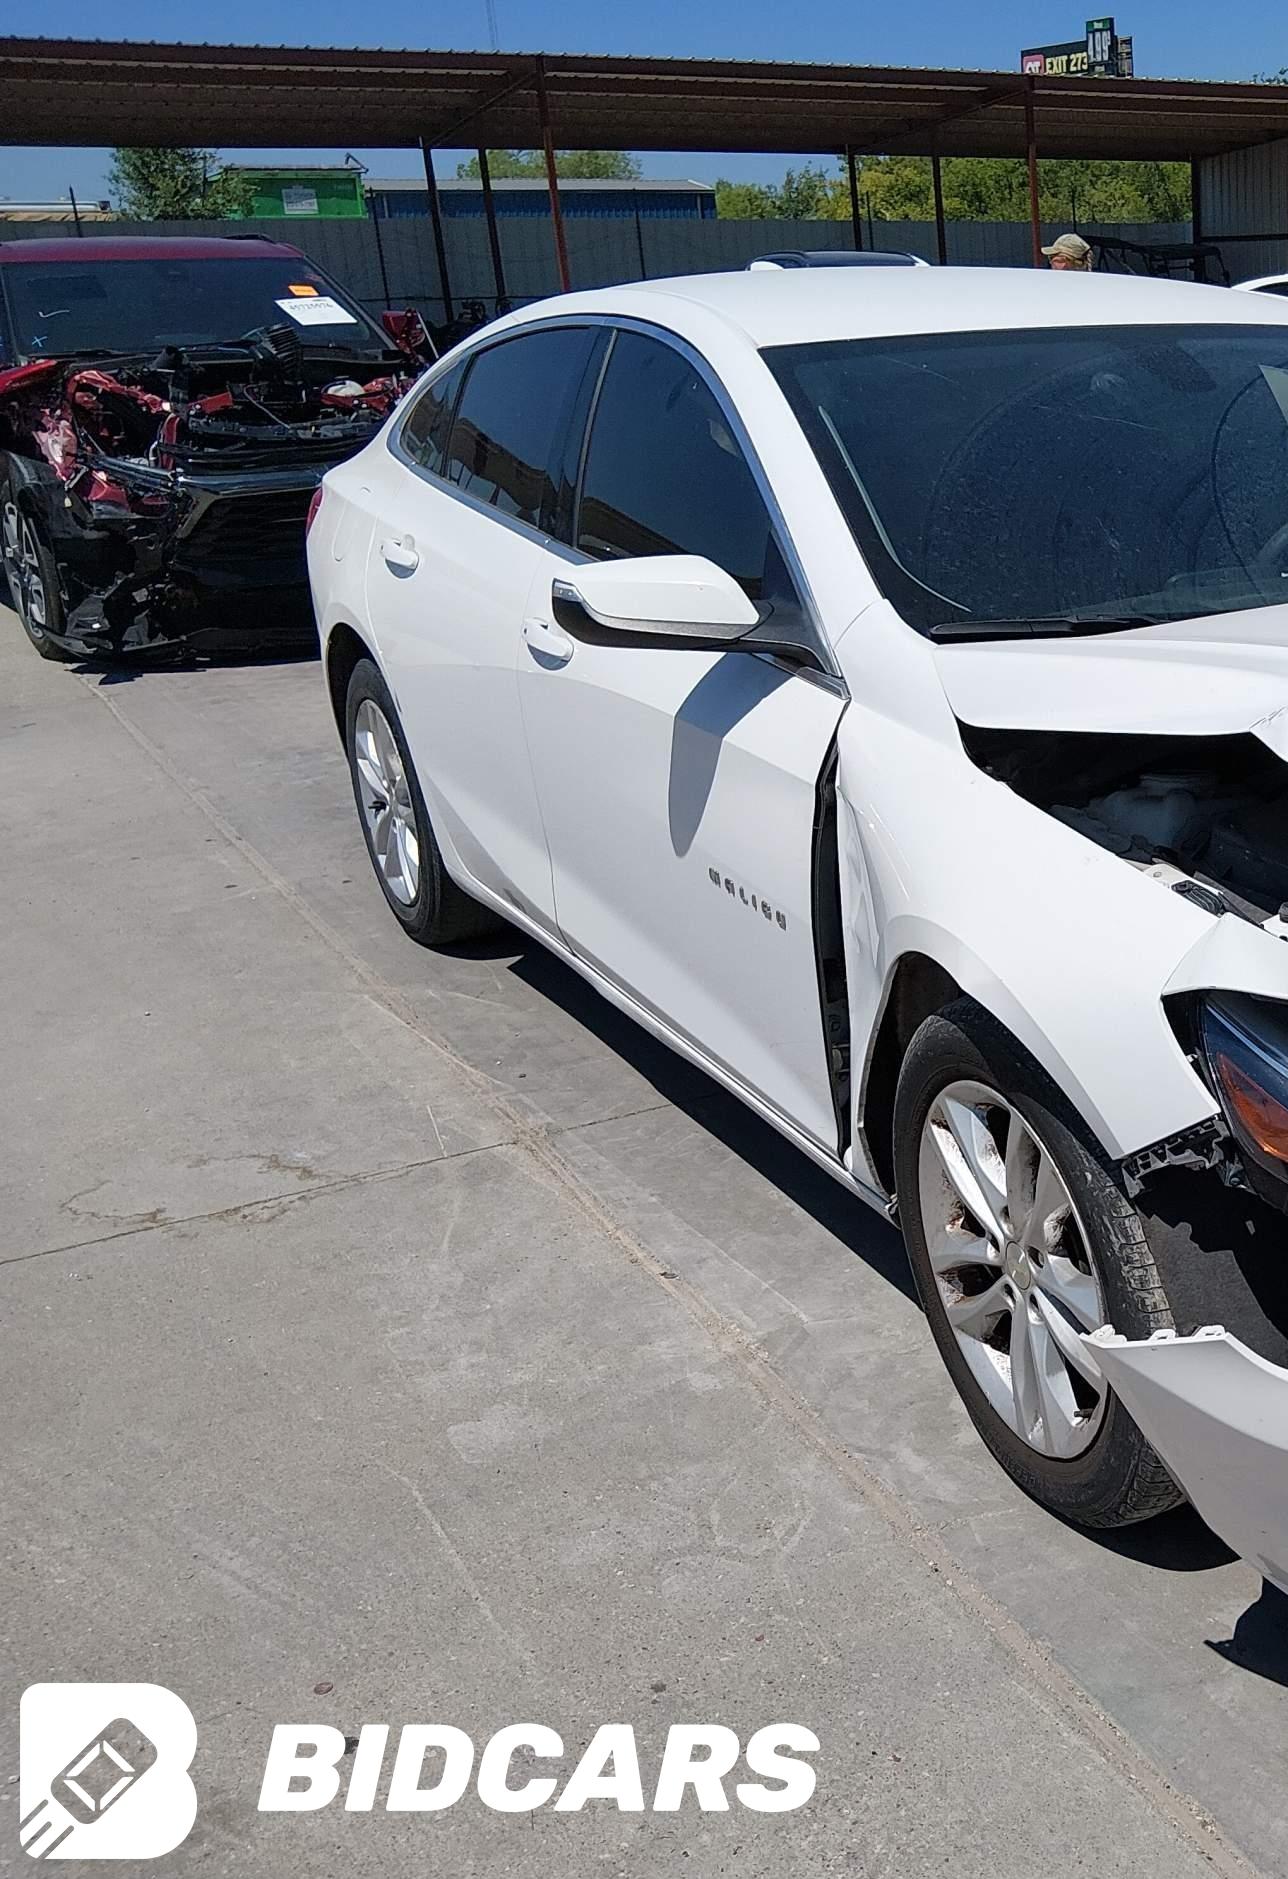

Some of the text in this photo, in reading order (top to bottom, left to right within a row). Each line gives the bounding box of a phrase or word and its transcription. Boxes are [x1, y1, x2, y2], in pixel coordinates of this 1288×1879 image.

[1046, 55, 1068, 74] EXIT
[1070, 51, 1088, 71] 273
[709, 868, 786, 931] MALIBU
